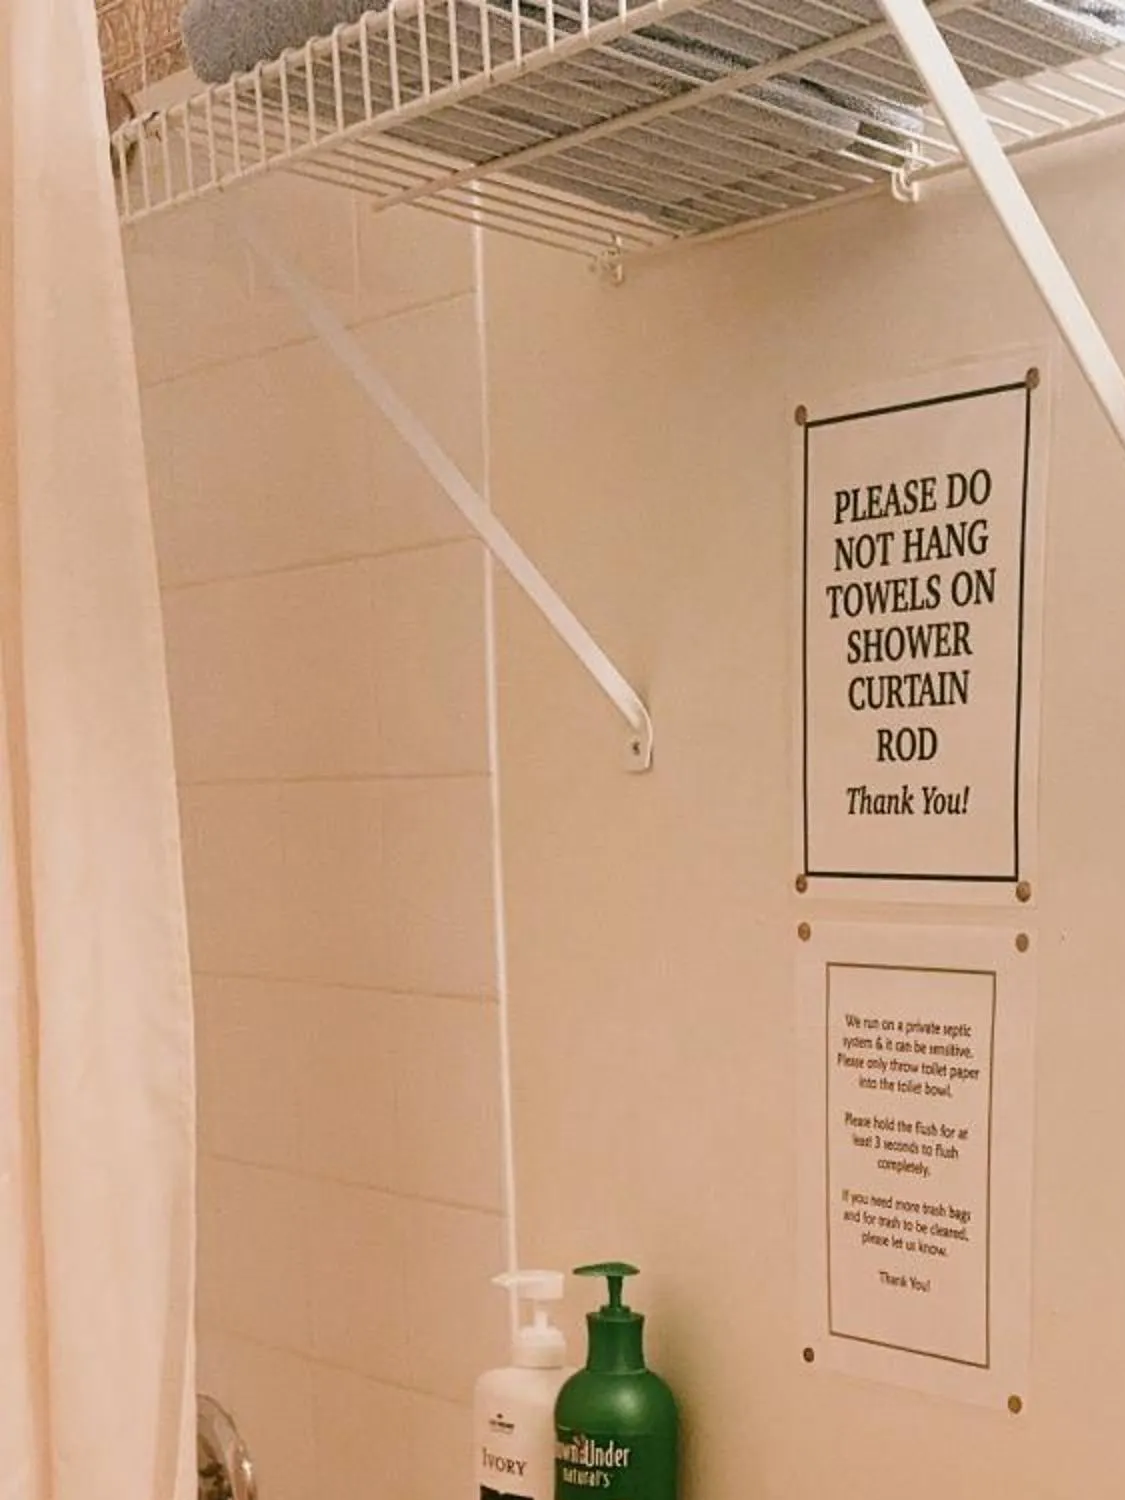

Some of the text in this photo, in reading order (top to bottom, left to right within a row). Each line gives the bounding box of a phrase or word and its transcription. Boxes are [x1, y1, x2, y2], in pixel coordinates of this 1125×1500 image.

[833, 468, 992, 525] PLEASE DO
[833, 519, 988, 571] NOT HANG
[826, 567, 997, 618] TOWELS ON
[847, 621, 973, 665] SHOWER
[848, 670, 970, 711] CURTAIN
[876, 726, 937, 762] ROD
[846, 784, 969, 816] Thank You!
[845, 1014, 972, 1039] We run on a private septic
[843, 1036, 974, 1059] system & it can be sensitive.
[837, 1053, 980, 1081] Please only throw toilet paper
[859, 1076, 952, 1098] into the toilet bowl.
[844, 1112, 969, 1140] Please hold the flush for at
[852, 1134, 959, 1159] least 3 seconds to flush
[877, 1158, 931, 1178] completely.
[842, 1188, 971, 1224] If you need more trash bags
[843, 1210, 861, 1223] and
[863, 1211, 877, 1225] for
[878, 1215, 901, 1229] trash
[903, 1219, 913, 1231] to
[915, 1220, 928, 1234] be
[861, 1231, 947, 1256] please let us know.
[879, 1271, 931, 1293] Thank You!
[482, 1446, 527, 1477] IVORY
[584, 1439, 631, 1468] Under
